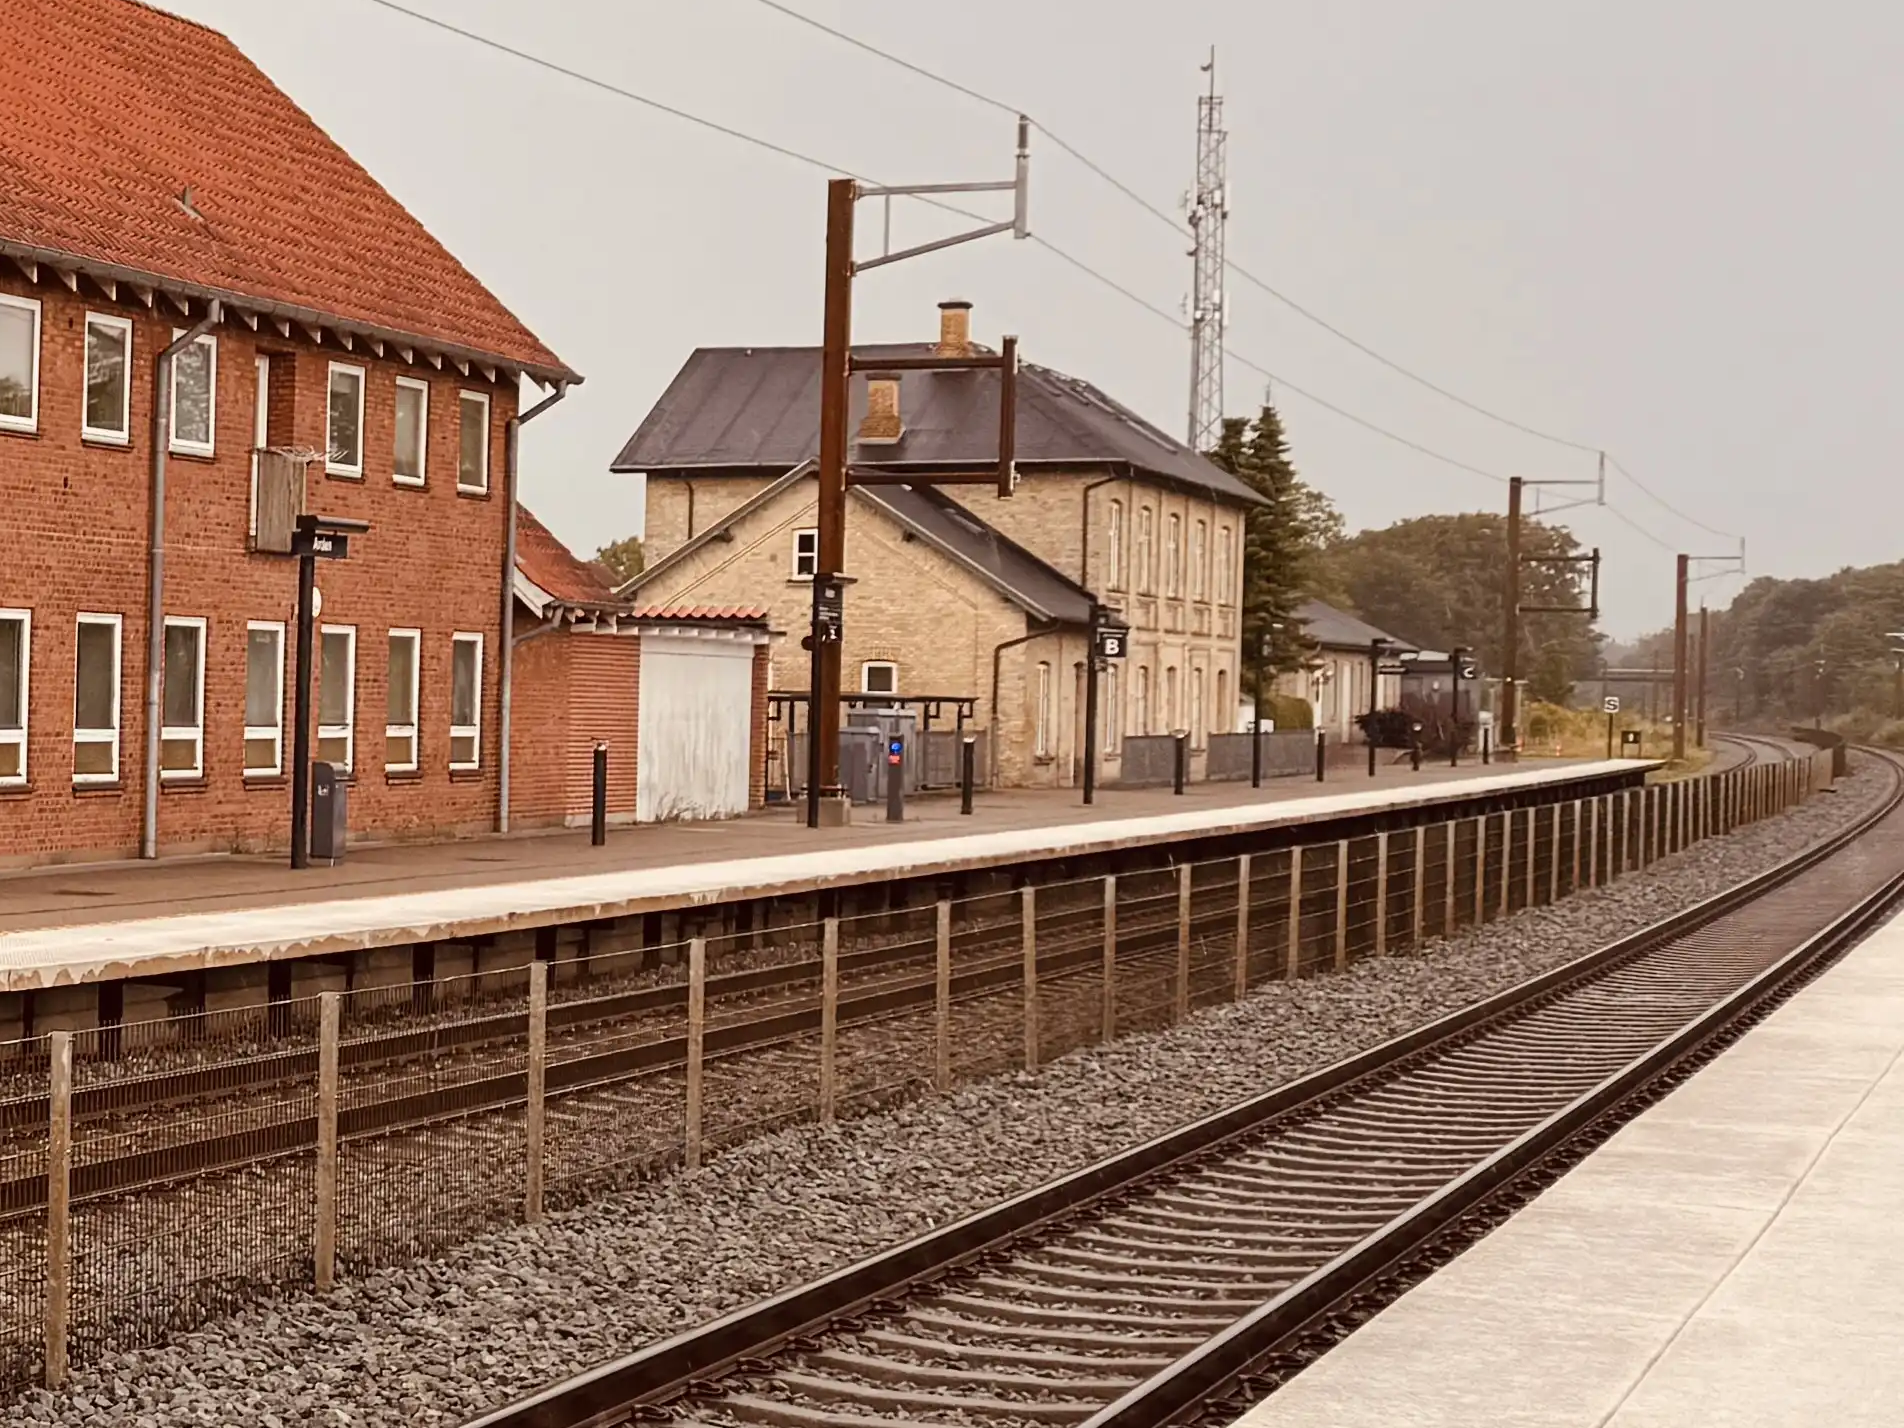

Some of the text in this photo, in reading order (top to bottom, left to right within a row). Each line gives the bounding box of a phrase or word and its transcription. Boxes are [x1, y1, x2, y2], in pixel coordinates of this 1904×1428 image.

[313, 536, 332, 552] Arden
[1105, 638, 1120, 655] B
[1607, 699, 1618, 711] S
